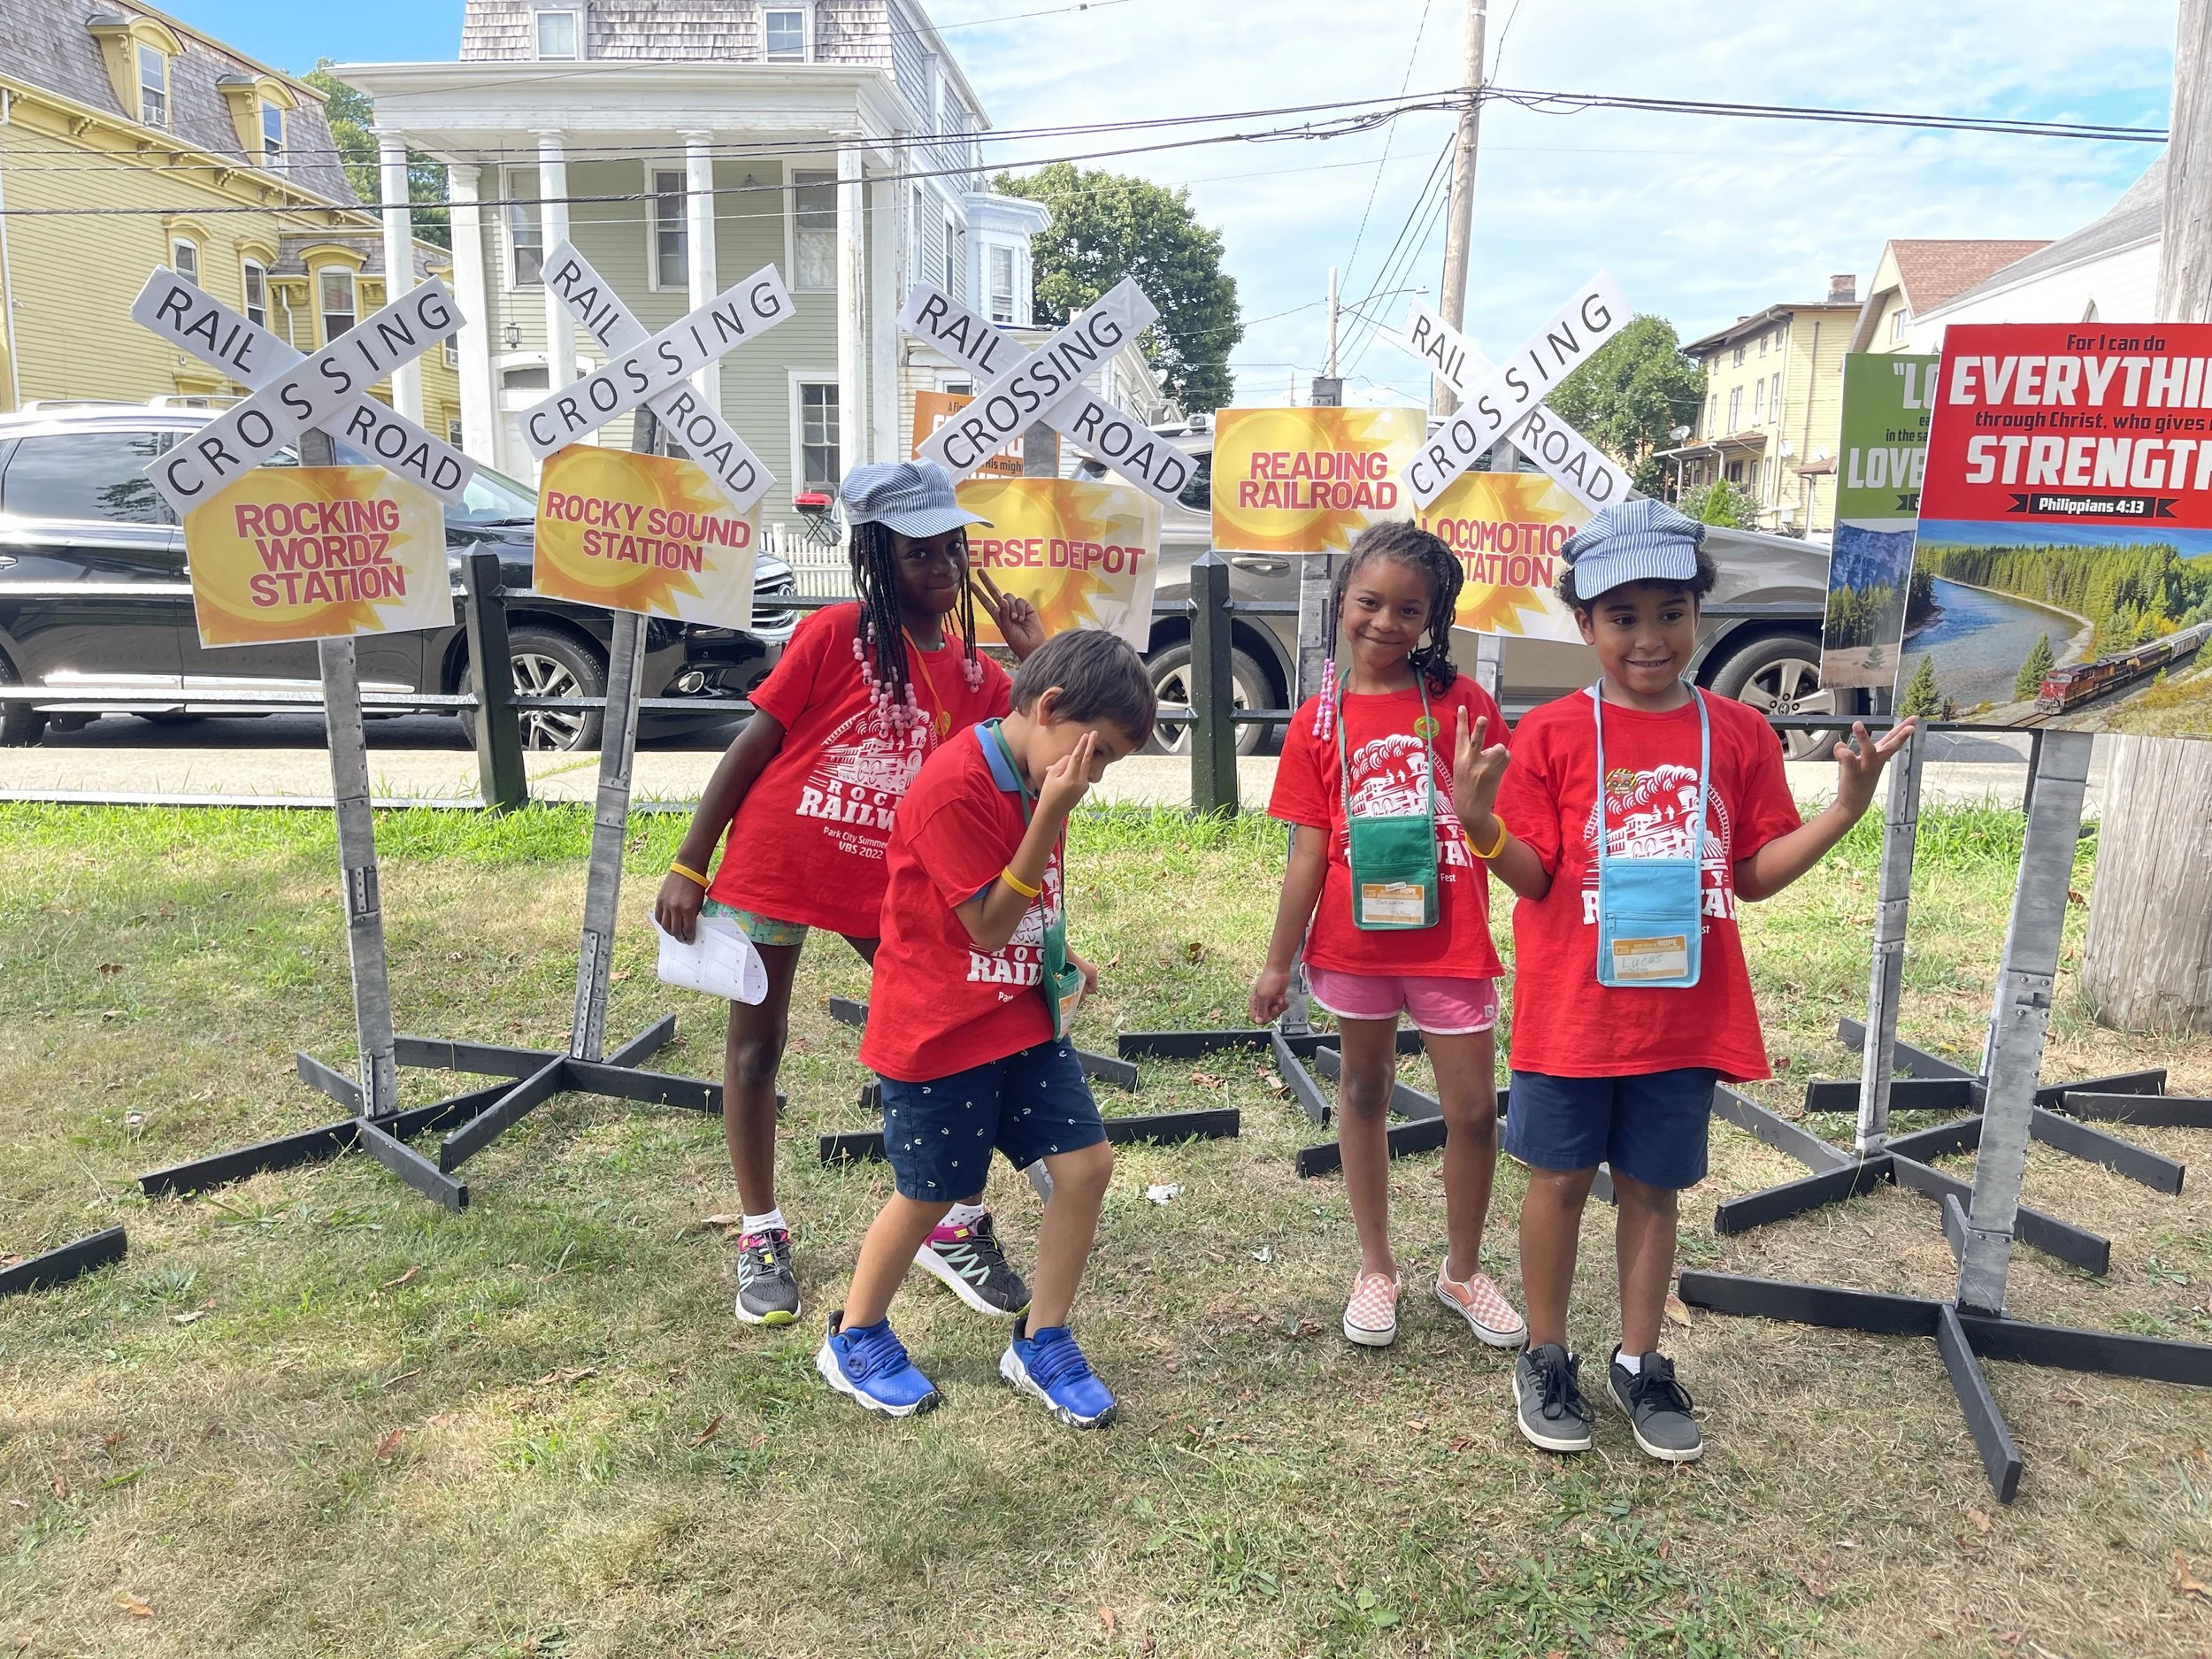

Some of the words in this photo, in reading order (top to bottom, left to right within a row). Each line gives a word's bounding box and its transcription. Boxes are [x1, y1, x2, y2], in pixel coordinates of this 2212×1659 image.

[529, 280, 780, 446] CROSSING
[2066, 334, 2096, 351] For
[2099, 334, 2105, 350] I
[2108, 338, 2139, 351] can
[2143, 335, 2166, 352] do
[156, 285, 255, 374] RAIL
[346, 404, 463, 492] ROAD
[165, 292, 451, 495] CROSSING
[552, 258, 622, 348] RAIL
[665, 392, 757, 495] ROAD
[915, 293, 1000, 375] RAIL
[1073, 402, 1188, 498] ROAD
[942, 309, 1124, 470] CROSSING
[1409, 290, 1613, 495] CROSSING
[1409, 312, 1466, 388] RAIL
[1522, 410, 1614, 502] ROAD
[1974, 411, 2046, 432] through
[2049, 411, 2108, 430] Christ,
[2113, 413, 2151, 430] who
[2154, 414, 2205, 434] gives
[1886, 429, 1895, 442] in
[1898, 428, 1915, 442] the
[1000, 460, 1024, 474] migh
[1249, 451, 1388, 482] READING
[1239, 481, 1398, 513] RAILROAD
[2038, 497, 2114, 515] Philippians
[2116, 500, 2145, 514] 4:13
[234, 499, 400, 539] ROCKING
[544, 490, 644, 526] ROCKY
[646, 508, 751, 549] SOUND
[1421, 518, 1580, 557] OCOMOTIO
[254, 533, 395, 573] WORDZ
[581, 529, 704, 574] STATION
[968, 538, 1044, 568] ERSE
[1049, 538, 1146, 576] DEPOT
[250, 566, 407, 608] STATION
[823, 826, 842, 839] Park
[841, 831, 858, 843] City
[838, 841, 858, 855] VBS
[858, 847, 884, 859] 2022
[1440, 872, 1456, 882] Fest
